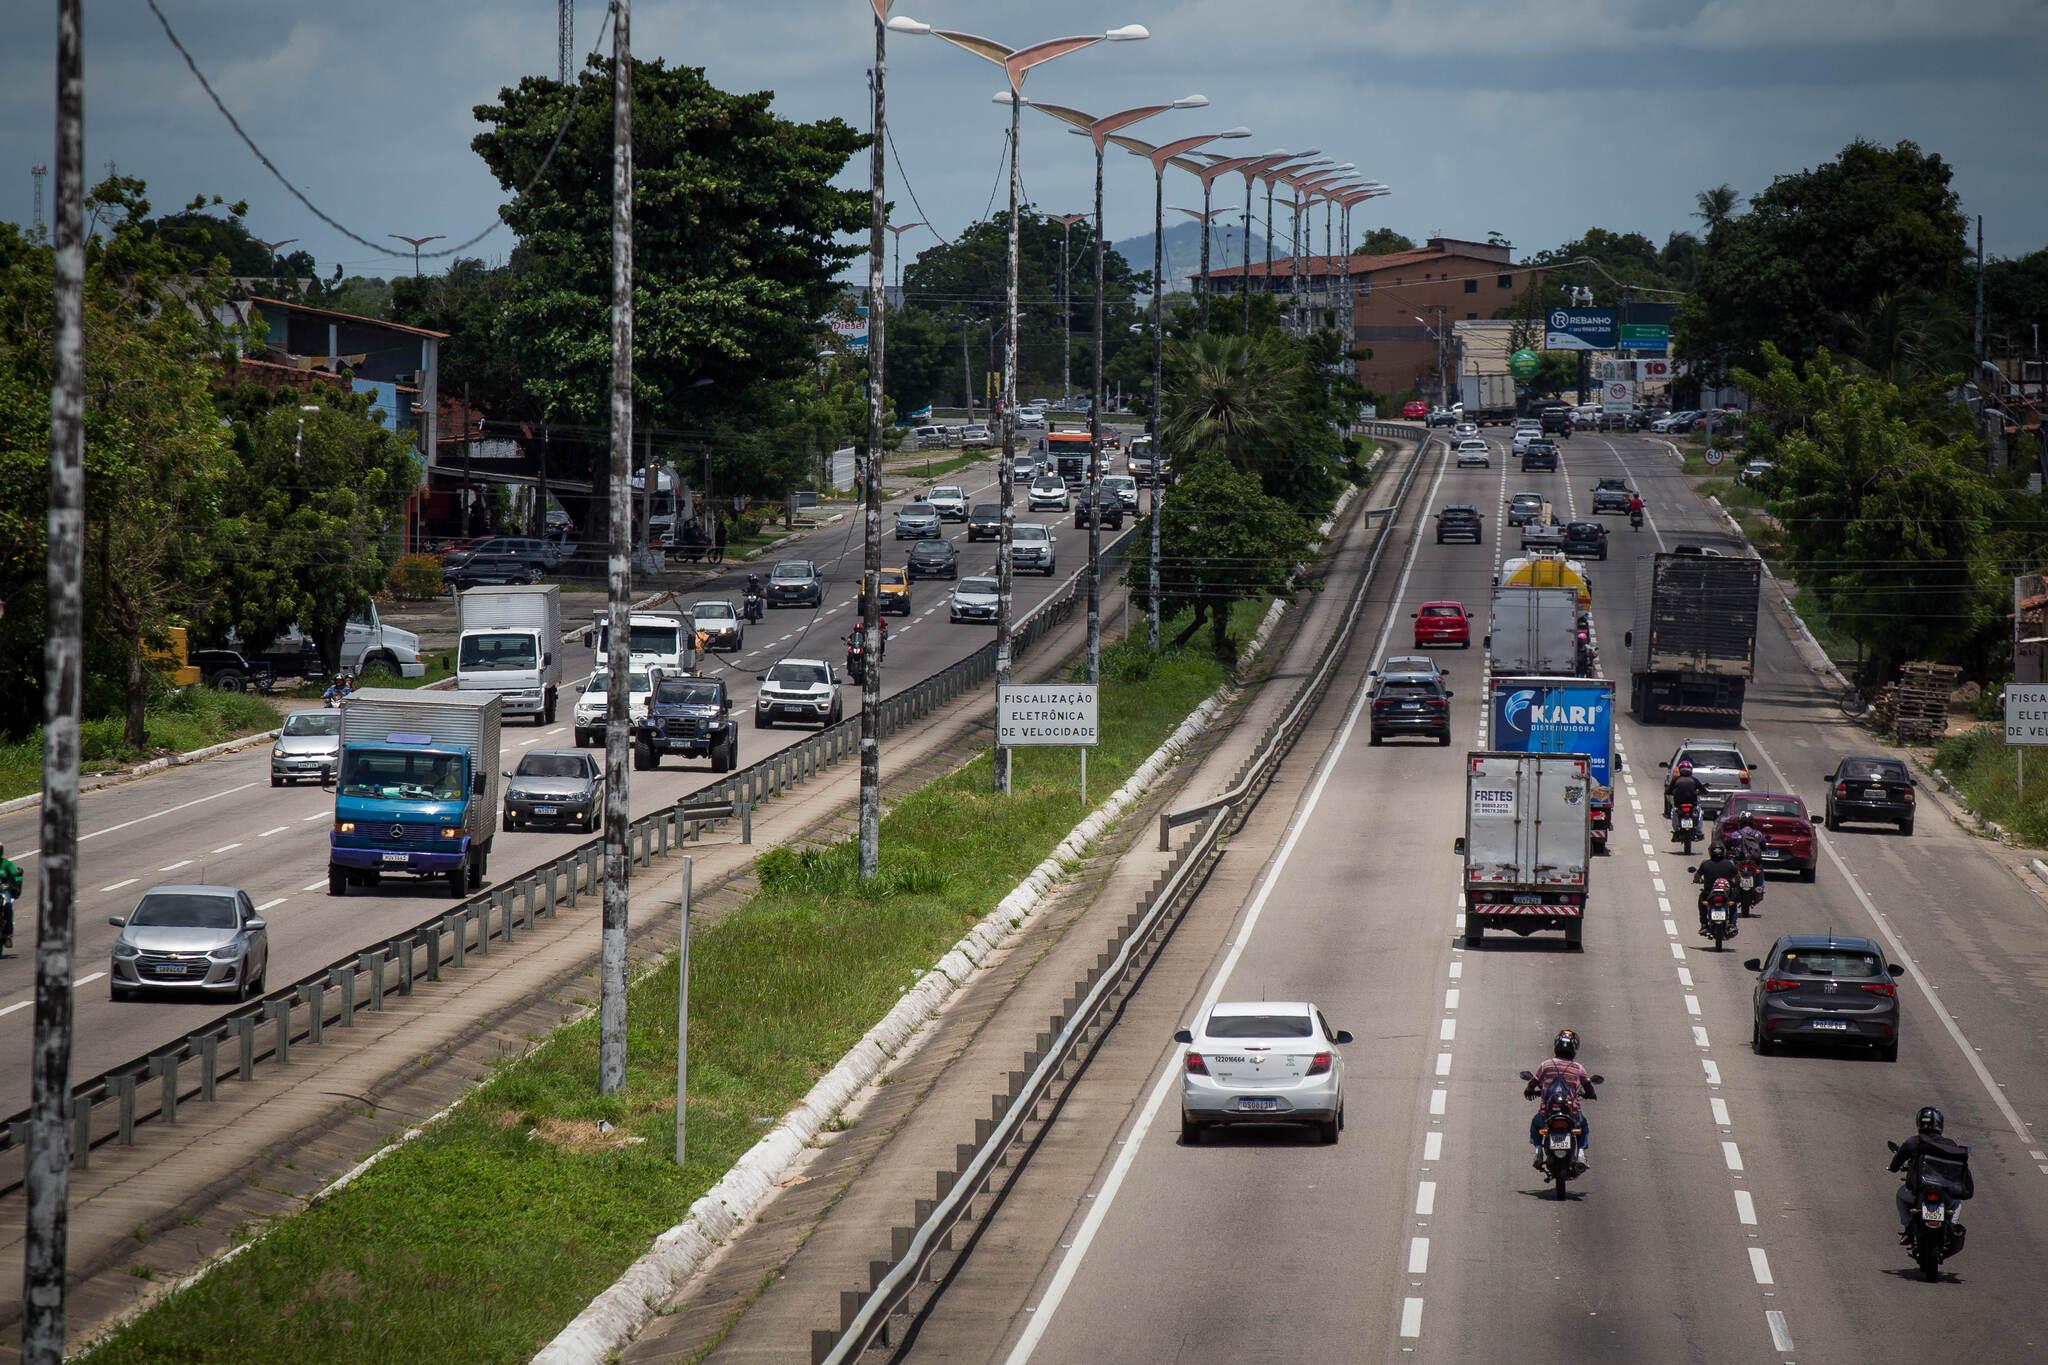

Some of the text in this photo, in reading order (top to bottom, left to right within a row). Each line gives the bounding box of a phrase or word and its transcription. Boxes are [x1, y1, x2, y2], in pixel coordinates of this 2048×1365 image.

[833, 321, 864, 329] Diesel
[1570, 316, 1611, 325] REBANHO
[1707, 450, 1721, 460] 60
[1004, 692, 1092, 705] FISCALIZAÇÃO
[2011, 693, 2047, 703] FISCA
[1012, 709, 1084, 721] ELETRÔNICA
[1531, 705, 1596, 725] KARI
[1001, 728, 1095, 737] DE VELOCIDADE
[2008, 727, 2023, 736] DE
[1474, 790, 1513, 802] FRETES
